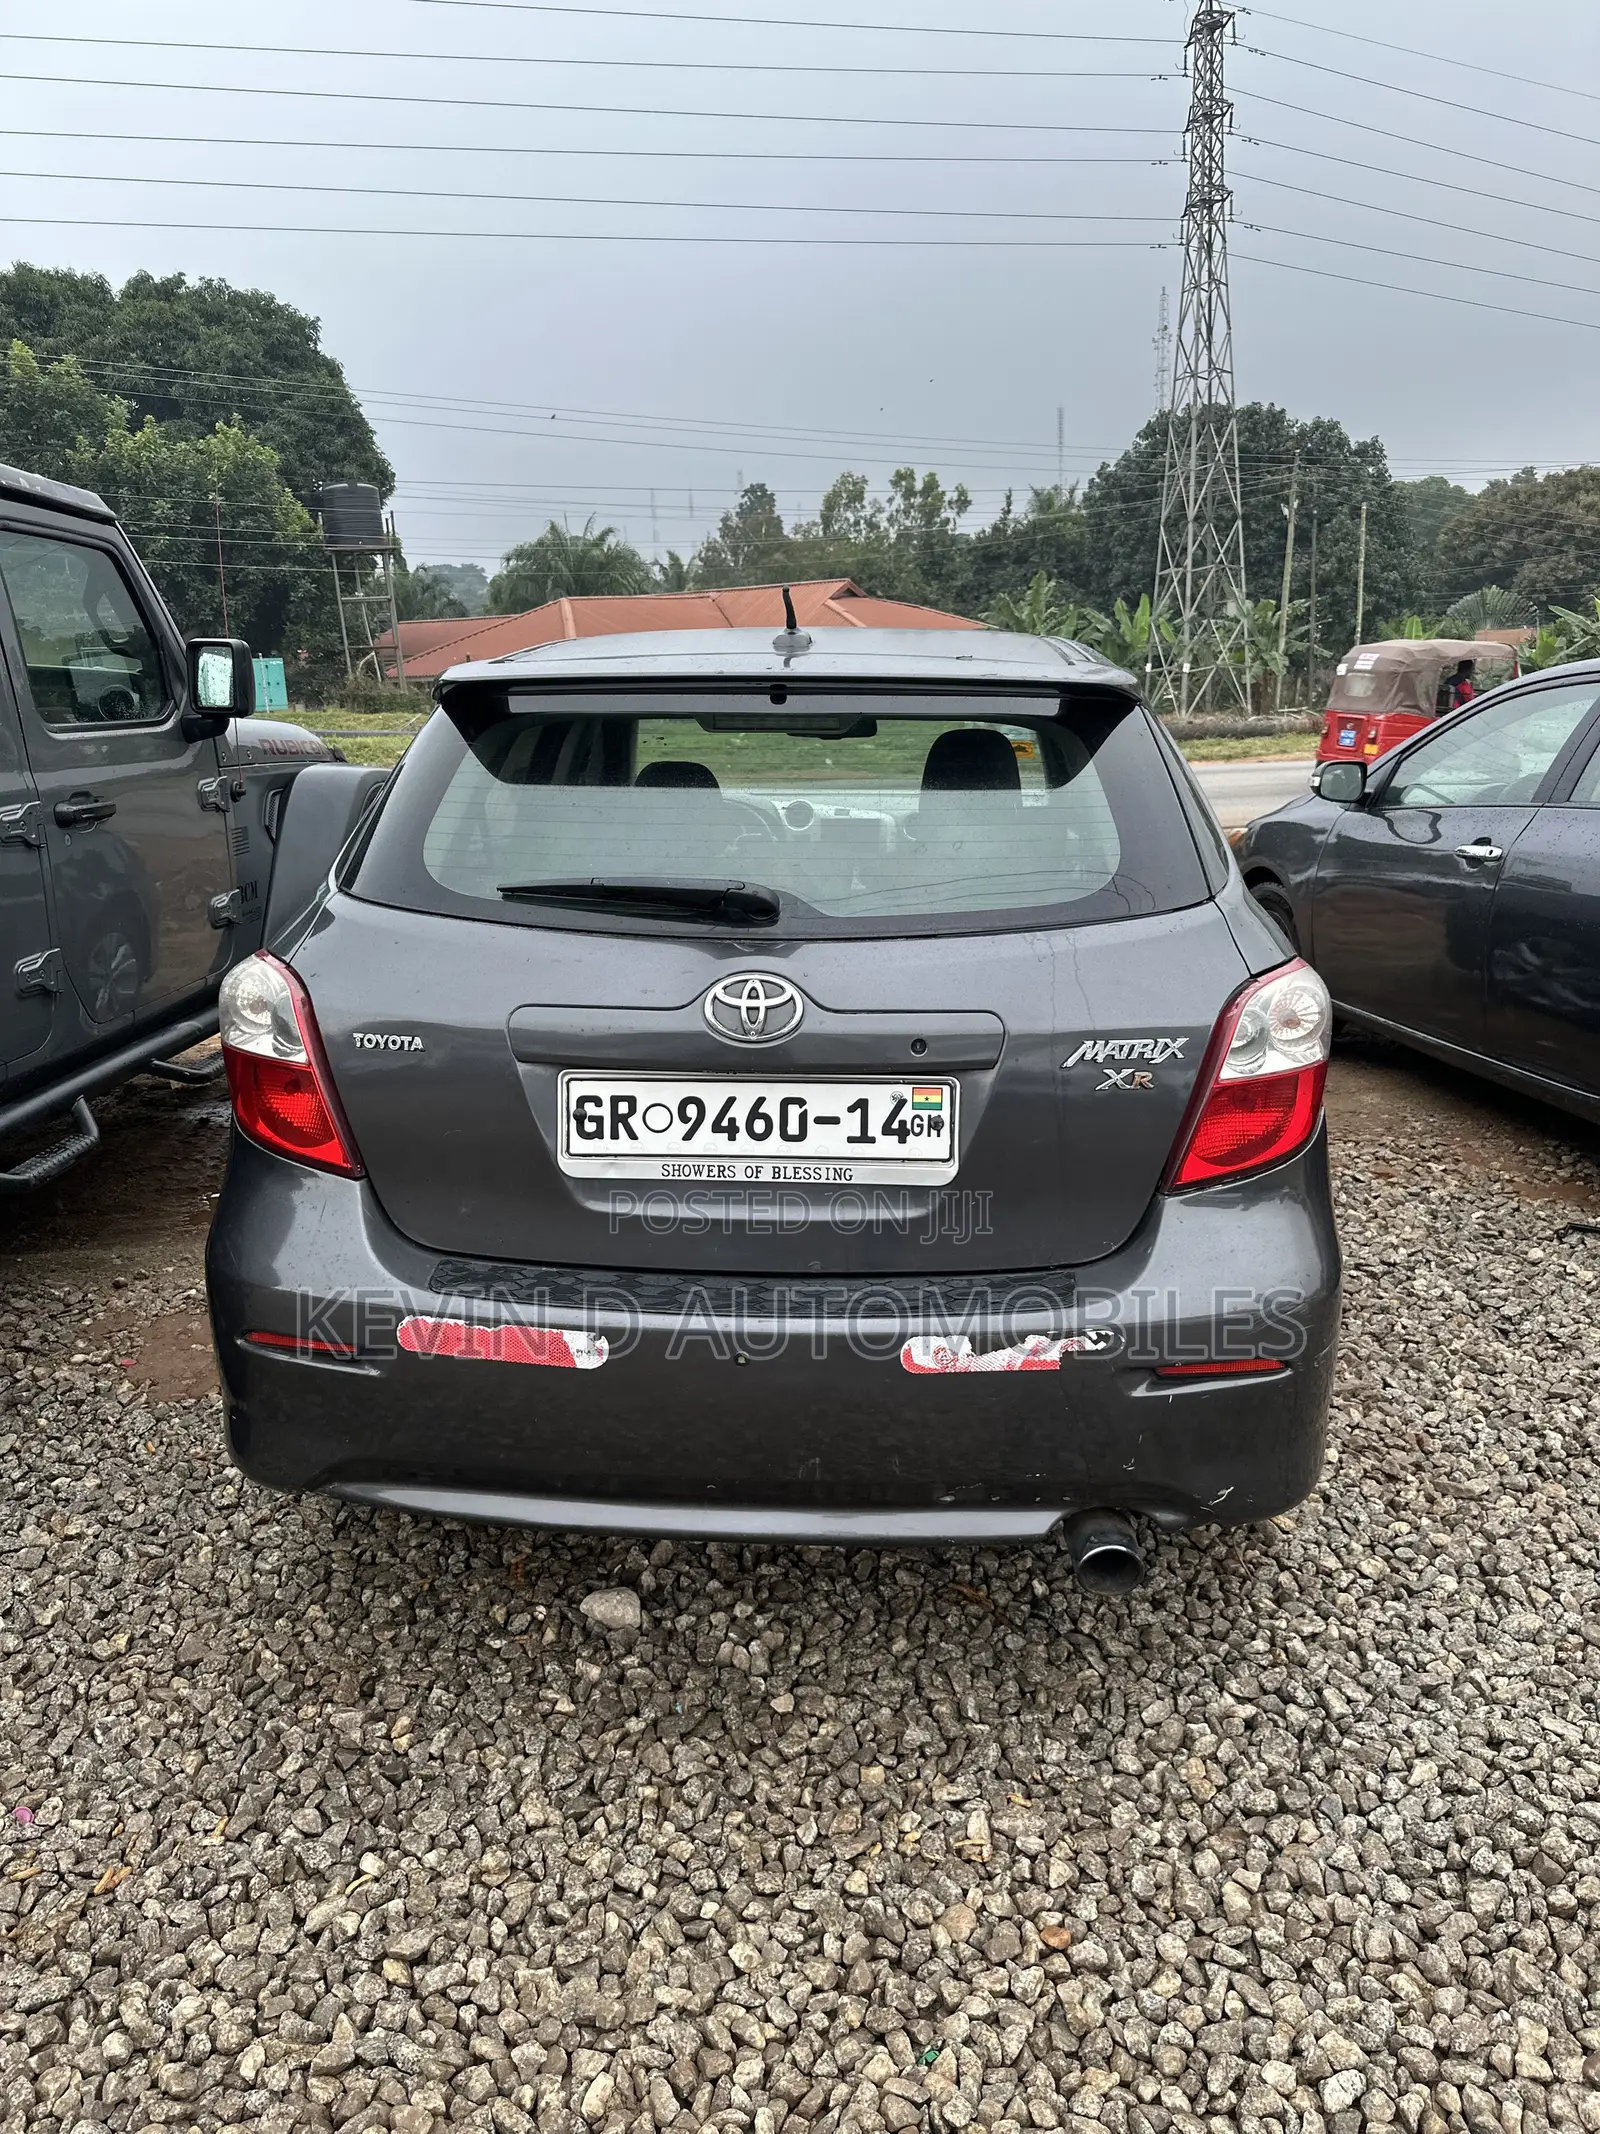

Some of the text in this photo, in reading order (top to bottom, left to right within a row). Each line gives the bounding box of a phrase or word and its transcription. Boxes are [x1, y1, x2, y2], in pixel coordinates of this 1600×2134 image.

[352, 1032, 426, 1052] TOYOTA
[1060, 1036, 1189, 1069] MATRIX
[1094, 1068, 1155, 1090] XR
[661, 1164, 854, 1182] SHOWERS OF BLESSING
